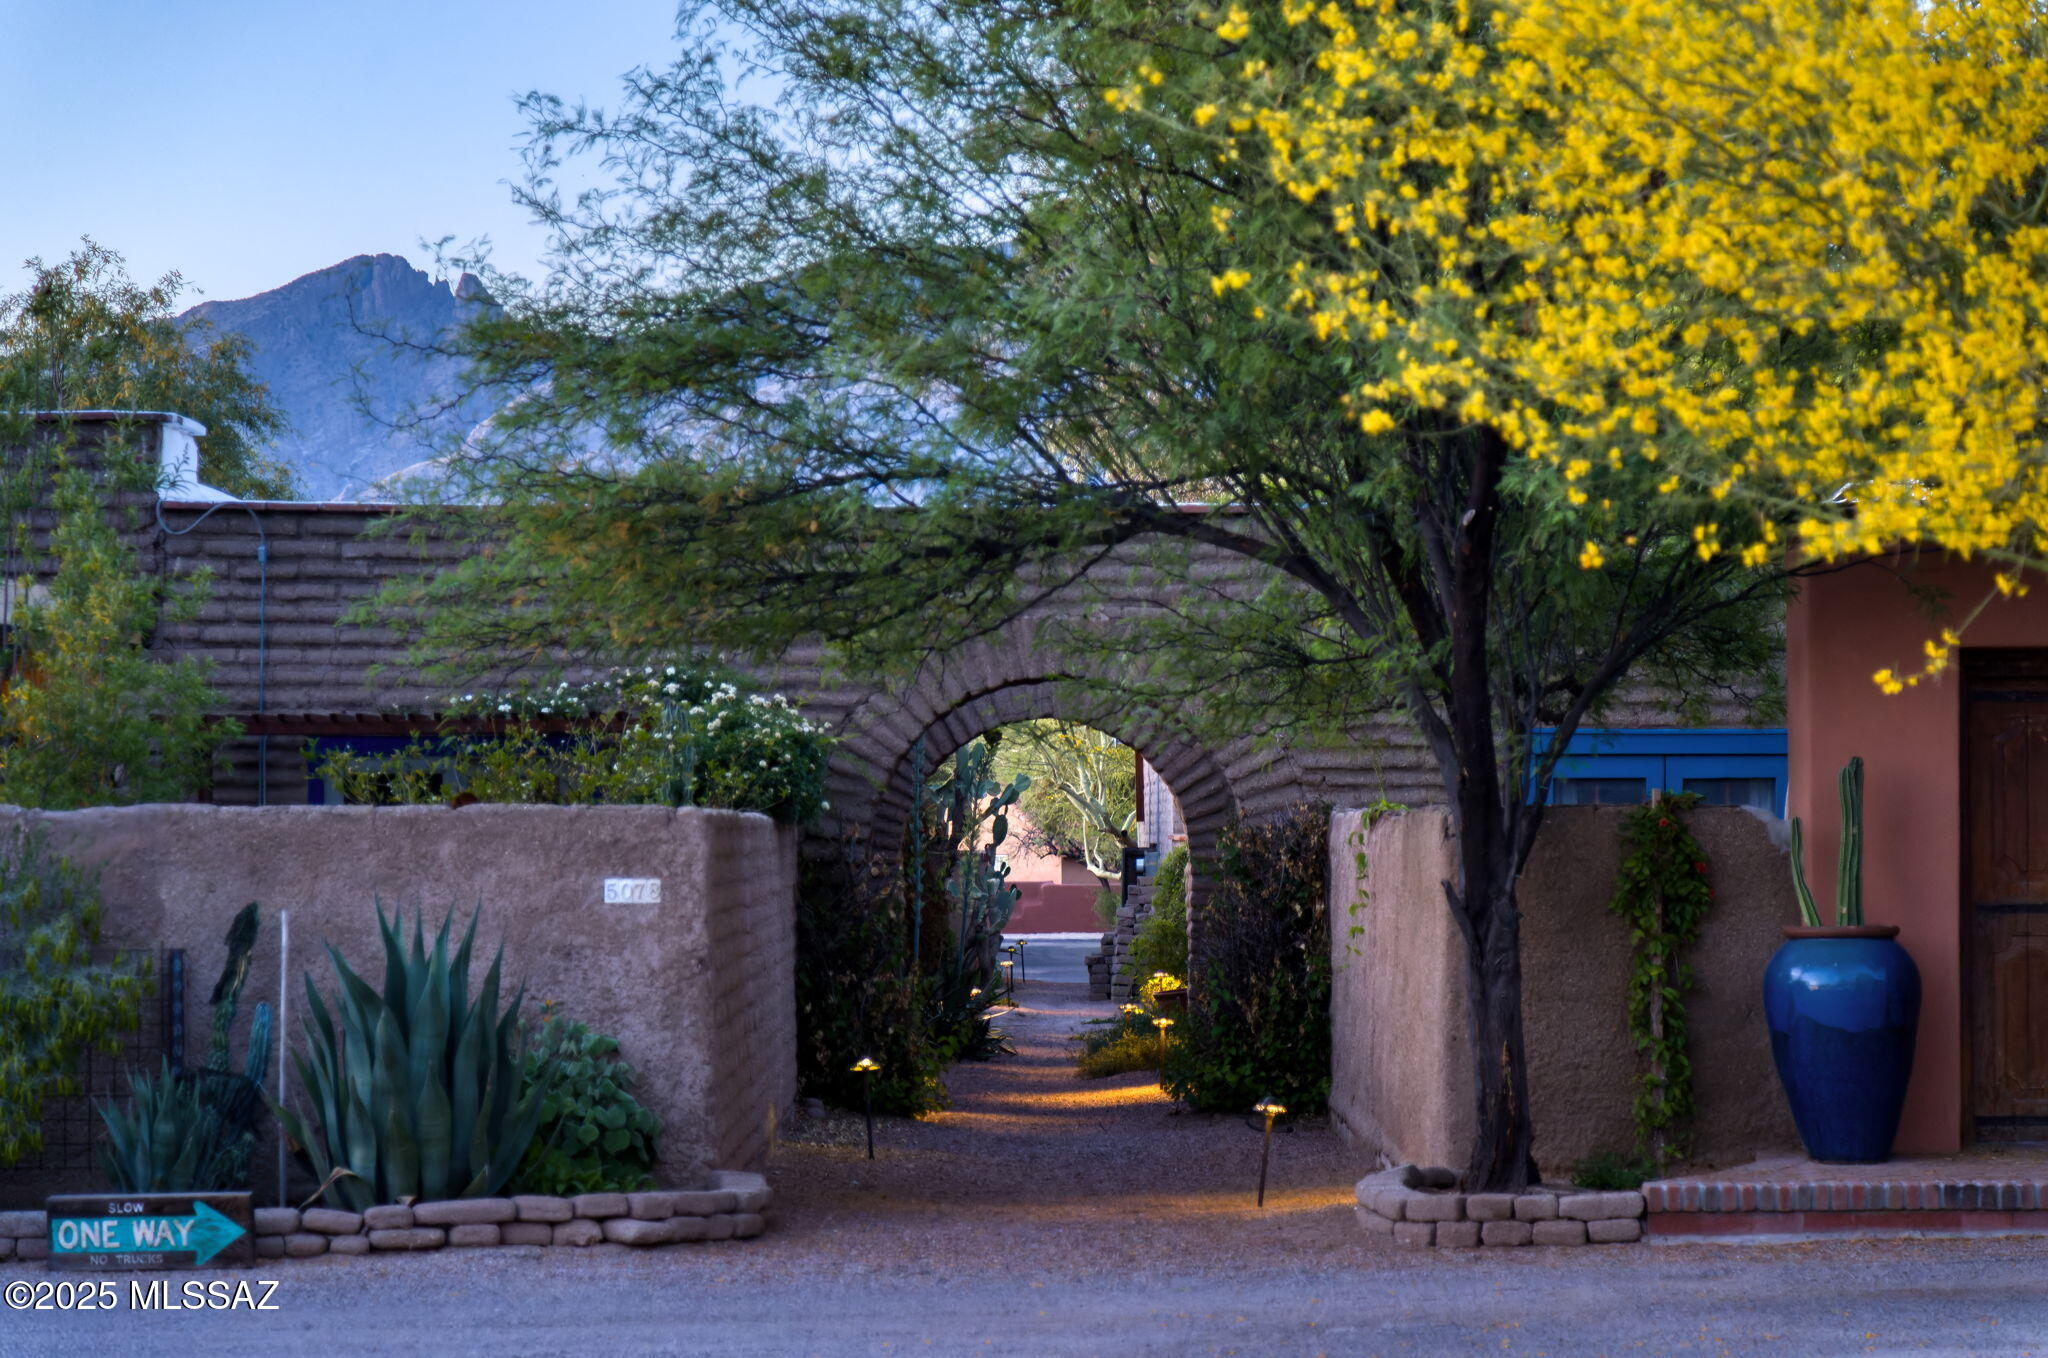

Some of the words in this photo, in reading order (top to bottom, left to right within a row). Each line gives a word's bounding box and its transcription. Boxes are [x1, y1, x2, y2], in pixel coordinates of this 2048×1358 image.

[108, 1202, 145, 1213] SLOW
[57, 1220, 120, 1249] ONE
[132, 1219, 195, 1247] WAY
[89, 1255, 108, 1265] NO
[116, 1254, 164, 1265] TRUCKS
